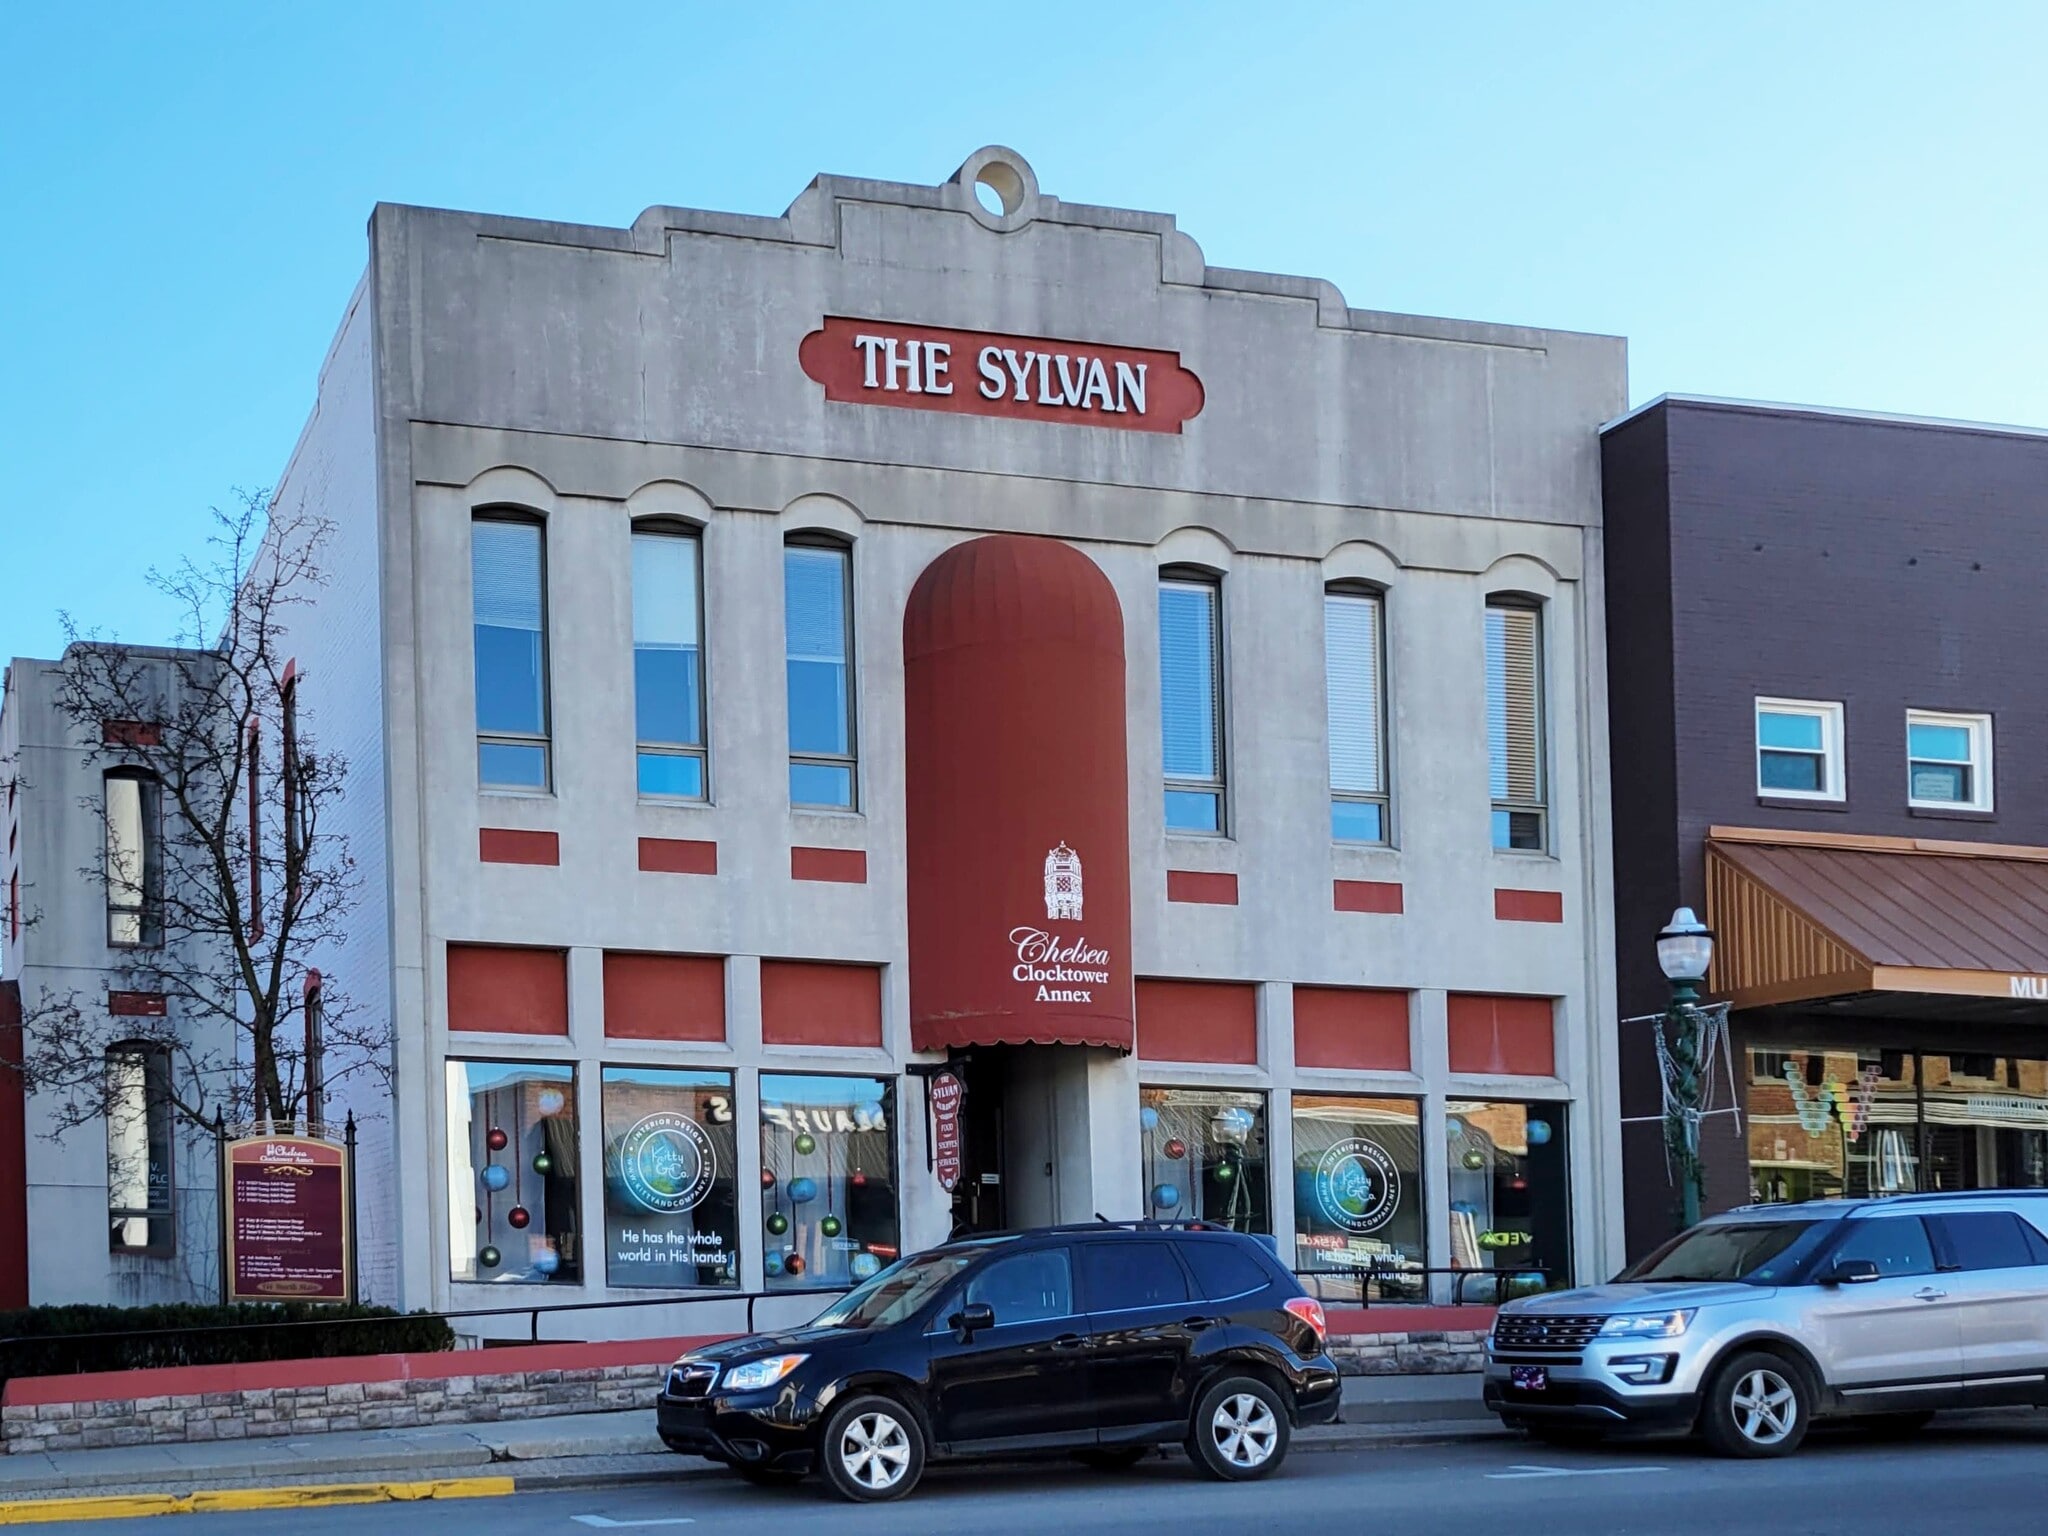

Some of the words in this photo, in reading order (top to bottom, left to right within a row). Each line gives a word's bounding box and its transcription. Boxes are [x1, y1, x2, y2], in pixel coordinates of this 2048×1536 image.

[855, 335, 953, 394] THE
[978, 346, 1148, 414] SYLVAN
[1009, 926, 1110, 965] Chelsea
[1012, 964, 1109, 984] Clocktower
[1035, 985, 1092, 1003] Annex
[933, 1084, 958, 1100] SYLVAN
[633, 1118, 670, 1142] INTERIOR
[674, 1119, 704, 1144] DESIGN
[651, 1145, 684, 1164] Kitty
[1326, 1143, 1360, 1165] INTERIOR
[1362, 1145, 1389, 1168] DESIGN
[622, 1229, 639, 1243] He
[642, 1229, 664, 1244] has
[666, 1229, 685, 1244] the
[687, 1230, 723, 1246] whole
[617, 1247, 651, 1262] world
[655, 1248, 666, 1262] in
[669, 1248, 689, 1263] His
[692, 1248, 728, 1263] hands
[1375, 1249, 1406, 1263] whole
